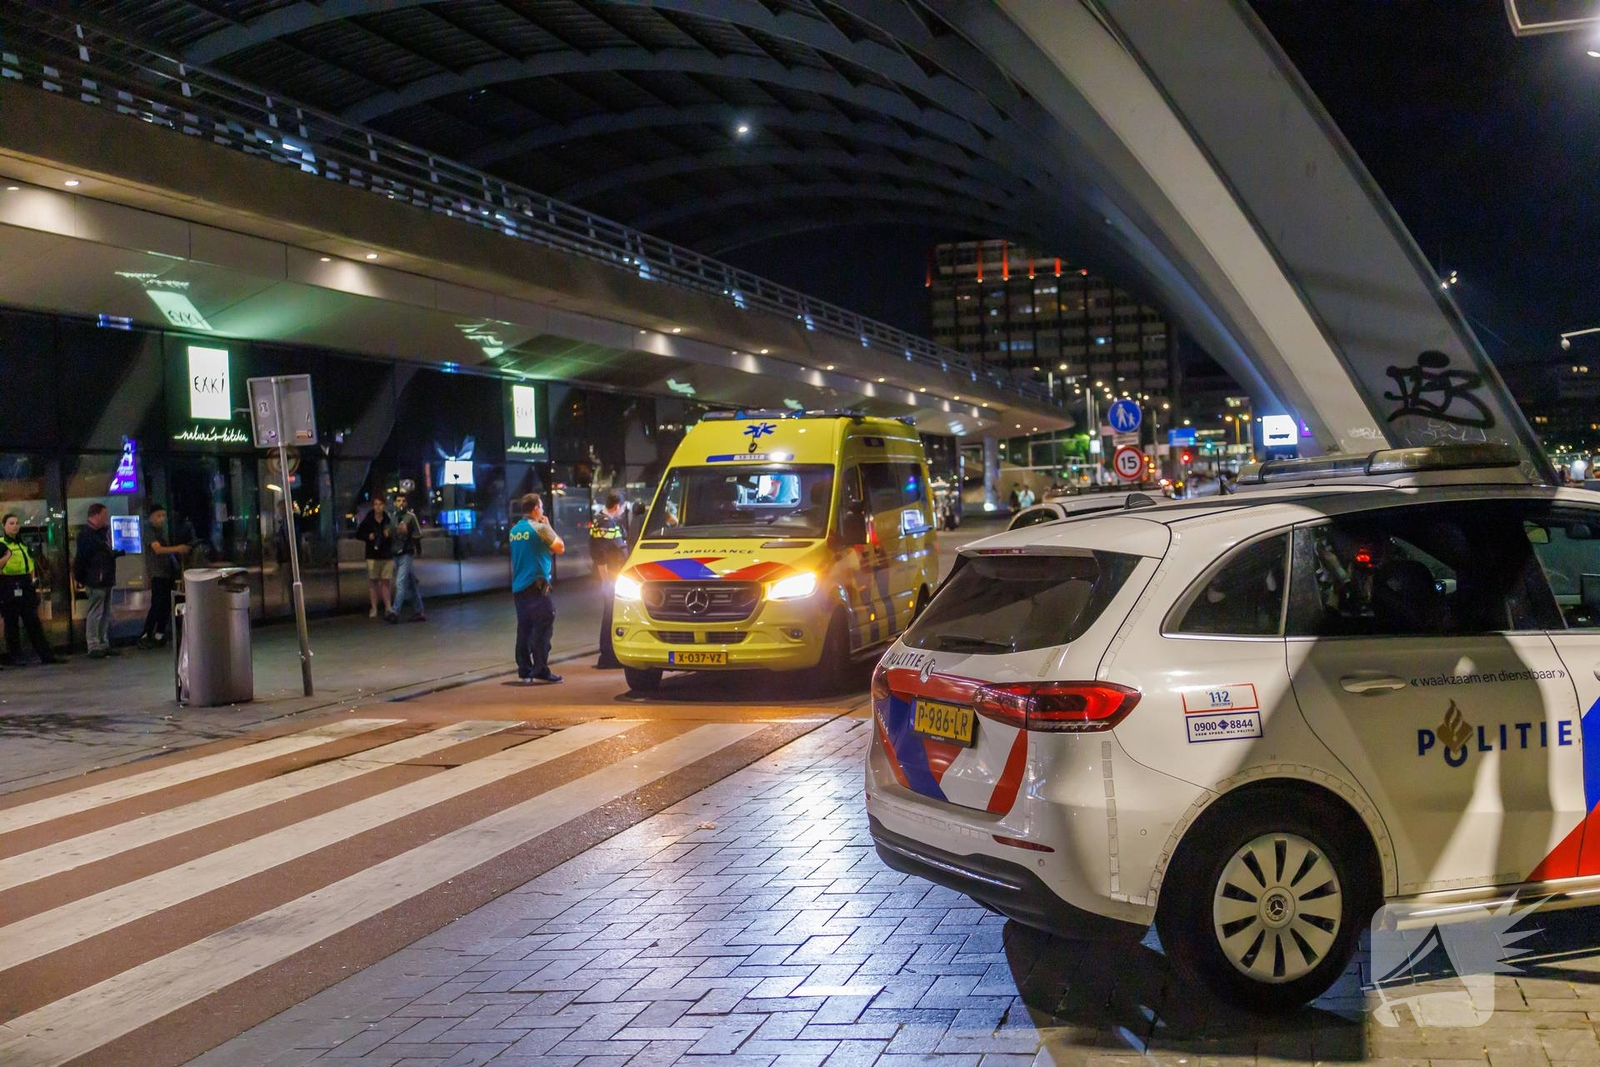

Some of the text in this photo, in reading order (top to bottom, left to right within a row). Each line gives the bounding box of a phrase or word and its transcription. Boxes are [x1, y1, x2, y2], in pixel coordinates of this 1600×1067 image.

[1121, 456, 1138, 470] 15
[678, 653, 722, 663] X-037-VZ
[1483, 673, 1497, 683] en
[917, 704, 969, 737] P-986-LR
[1194, 719, 1254, 732] 0900 8844
[1417, 720, 1573, 768] POLITIE
